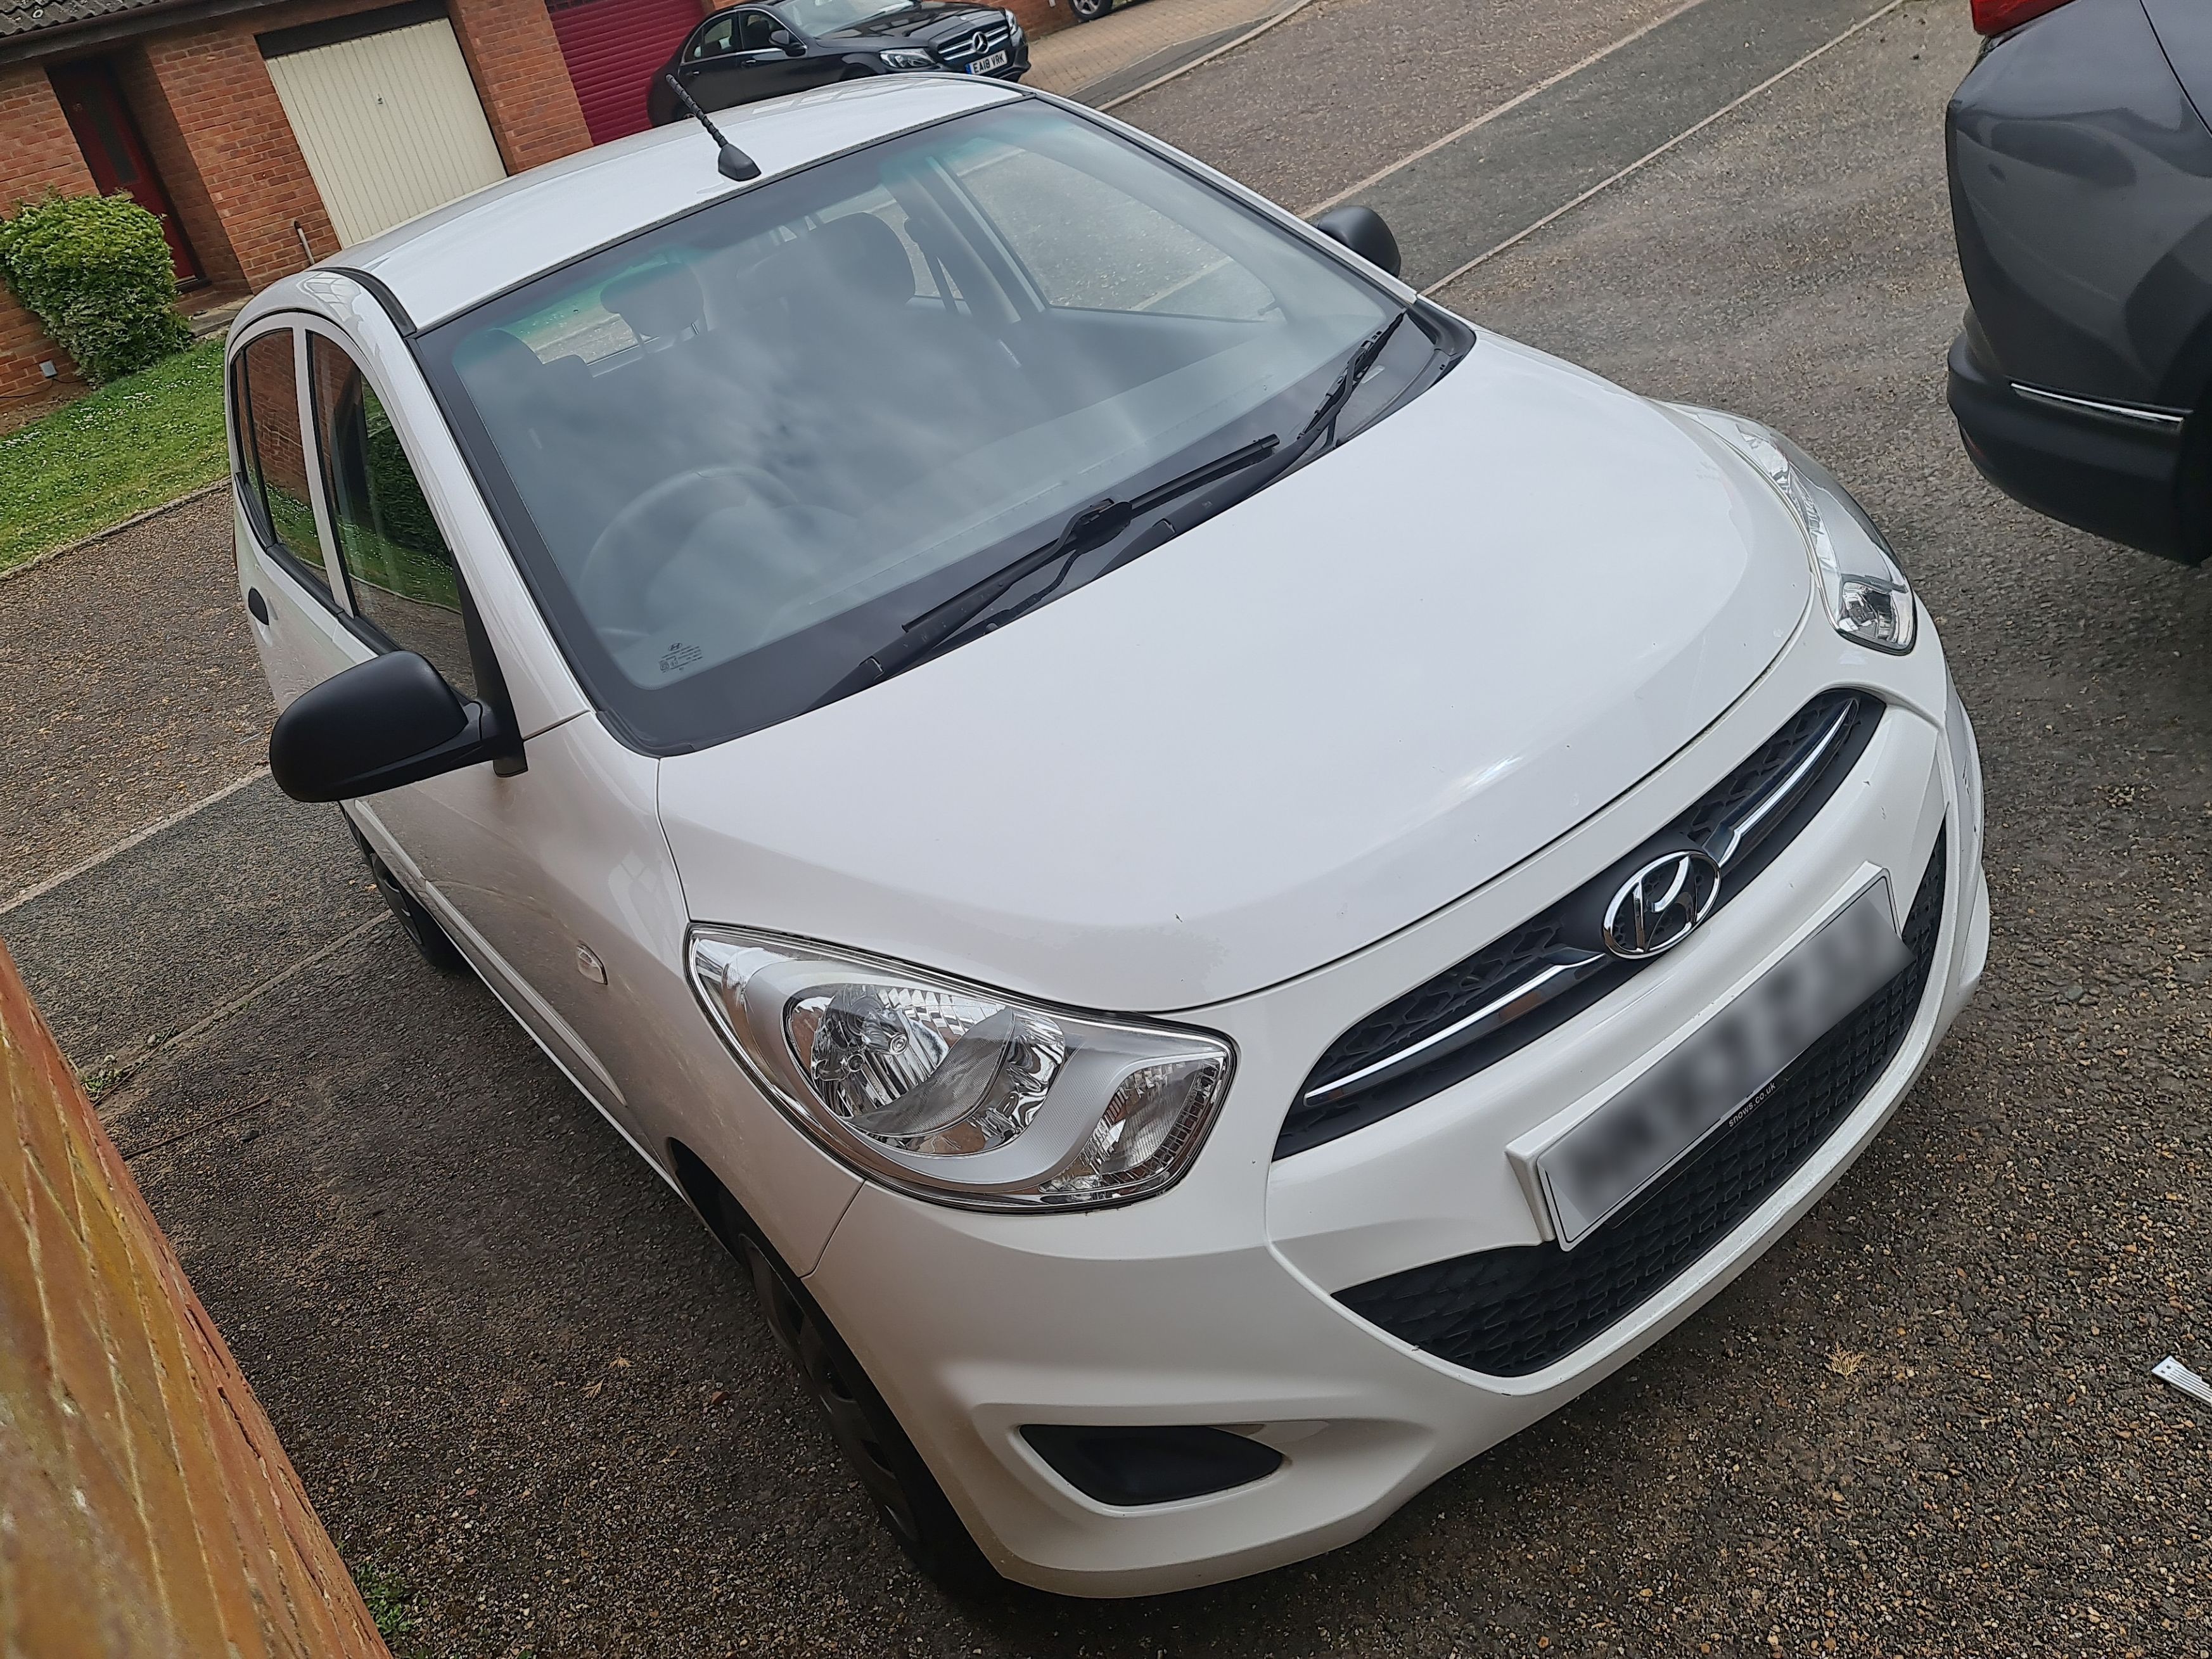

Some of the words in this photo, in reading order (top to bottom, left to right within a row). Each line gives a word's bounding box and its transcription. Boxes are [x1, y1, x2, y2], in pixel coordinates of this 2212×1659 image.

[973, 58, 990, 74] EA18
[991, 53, 1004, 67] VRK
[1728, 1082, 1776, 1127] snows.co.uk
